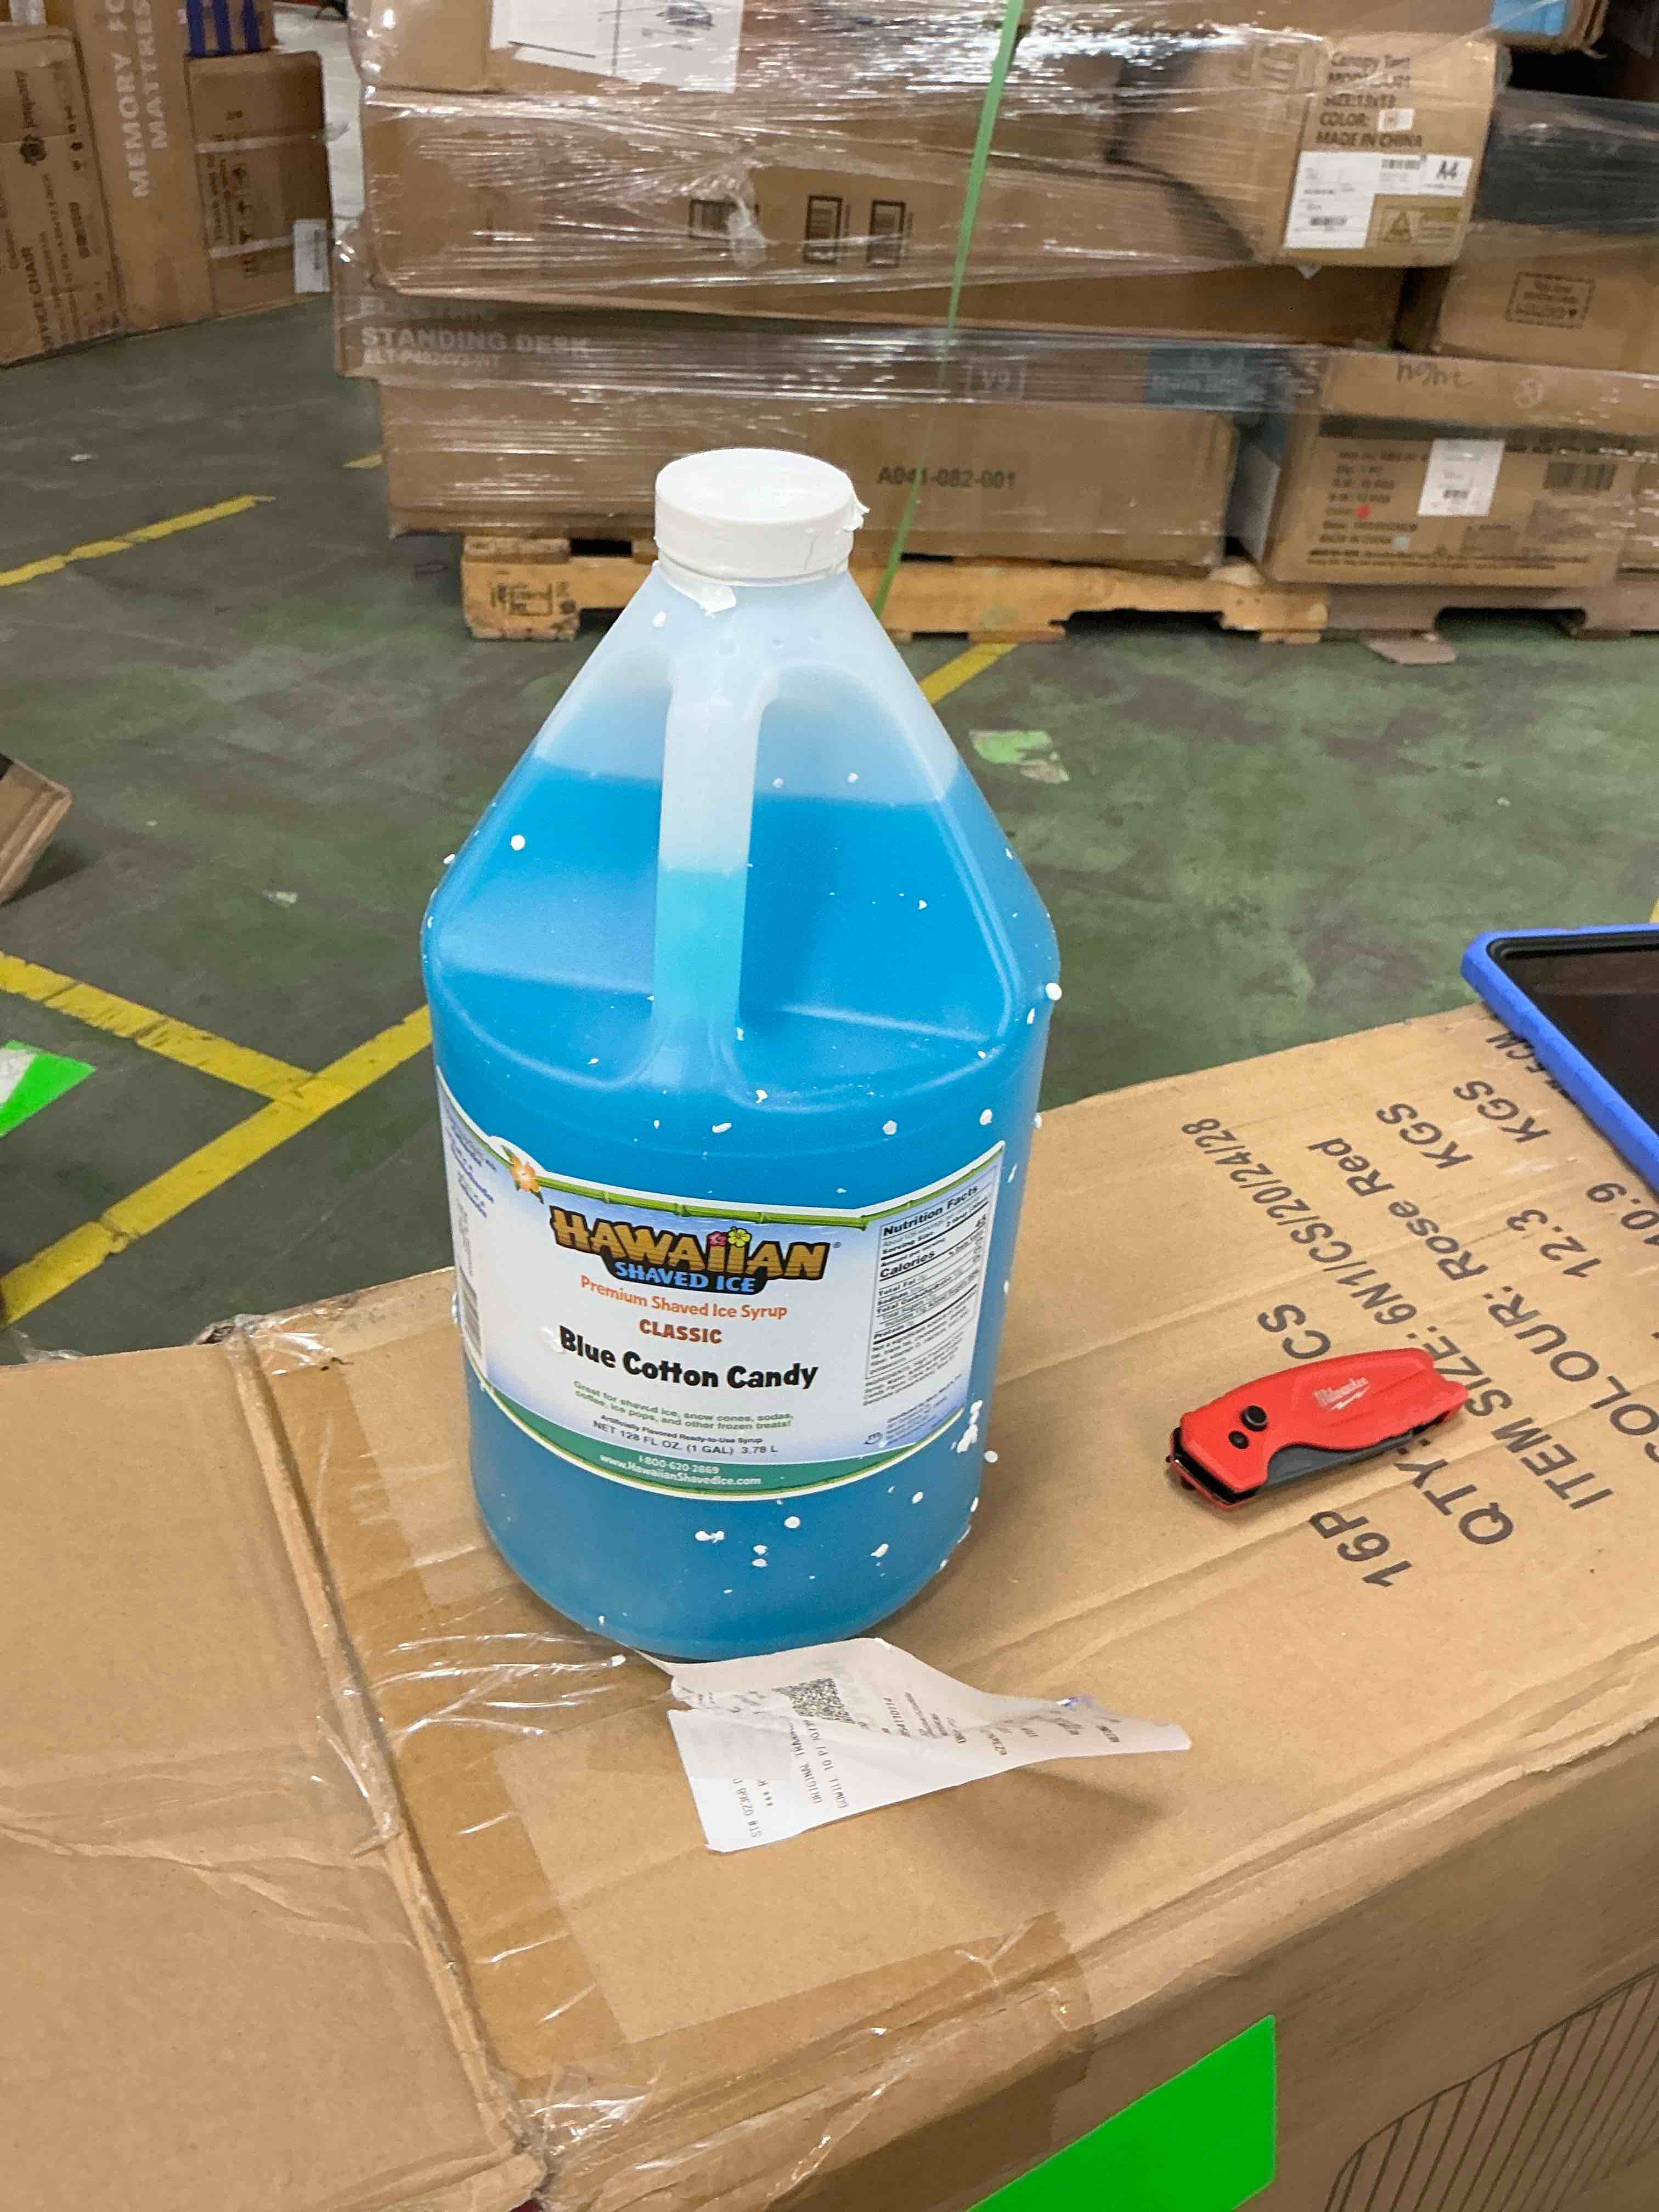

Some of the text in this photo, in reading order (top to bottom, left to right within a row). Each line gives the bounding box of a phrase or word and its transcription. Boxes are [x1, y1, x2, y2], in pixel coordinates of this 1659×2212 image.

[111, 53, 150, 198] MEMORY
[1315, 131, 1423, 148] MADE IN CHINA
[1436, 160, 1459, 179] A4
[361, 327, 507, 352] STANDING
[1453, 1080, 1551, 1143] KGS
[1376, 1103, 1601, 1278] 12.3 KGS
[883, 1206, 944, 1237] Nutrition
[946, 1186, 978, 1210] Facts
[549, 1205, 831, 1280] HAWAIIAN
[882, 1239, 916, 1255] Serving
[615, 1261, 756, 1293] SHAVED ICE
[879, 1250, 935, 1278] Calories
[581, 1274, 788, 1321] Premium Shaved Ice Syrup
[878, 1284, 900, 1296] Total
[903, 1279, 916, 1287] Fat
[1307, 1137, 1659, 1463] OLOUR: Rose Red
[639, 1318, 723, 1344] CLASSIC
[1181, 1118, 1613, 1510] ITEM SIZE: 6N1/CS/20/24/28
[559, 1325, 616, 1368] Blue
[622, 1350, 719, 1388] Cotton
[726, 1362, 819, 1390] Candy
[574, 1380, 600, 1396] Great
[603, 1392, 617, 1401] for
[620, 1399, 659, 1413] shaved
[684, 1413, 714, 1421] snow
[611, 1403, 626, 1414] ice
[661, 1417, 682, 1426] and
[685, 1421, 714, 1429] other
[592, 1420, 618, 1434] NET
[620, 1430, 640, 1442] 128
[643, 1436, 659, 1446] FL
[686, 1444, 697, 1454] (1
[702, 1445, 735, 1456] GAL)
[741, 1446, 767, 1455] 3.78
[642, 1426, 678, 1438] Flavored
[1257, 1304, 1514, 1545] QTY: CS
[600, 1454, 762, 1485] www.HawaiianShavedIce.com
[1309, 1511, 1412, 1587] 16P
